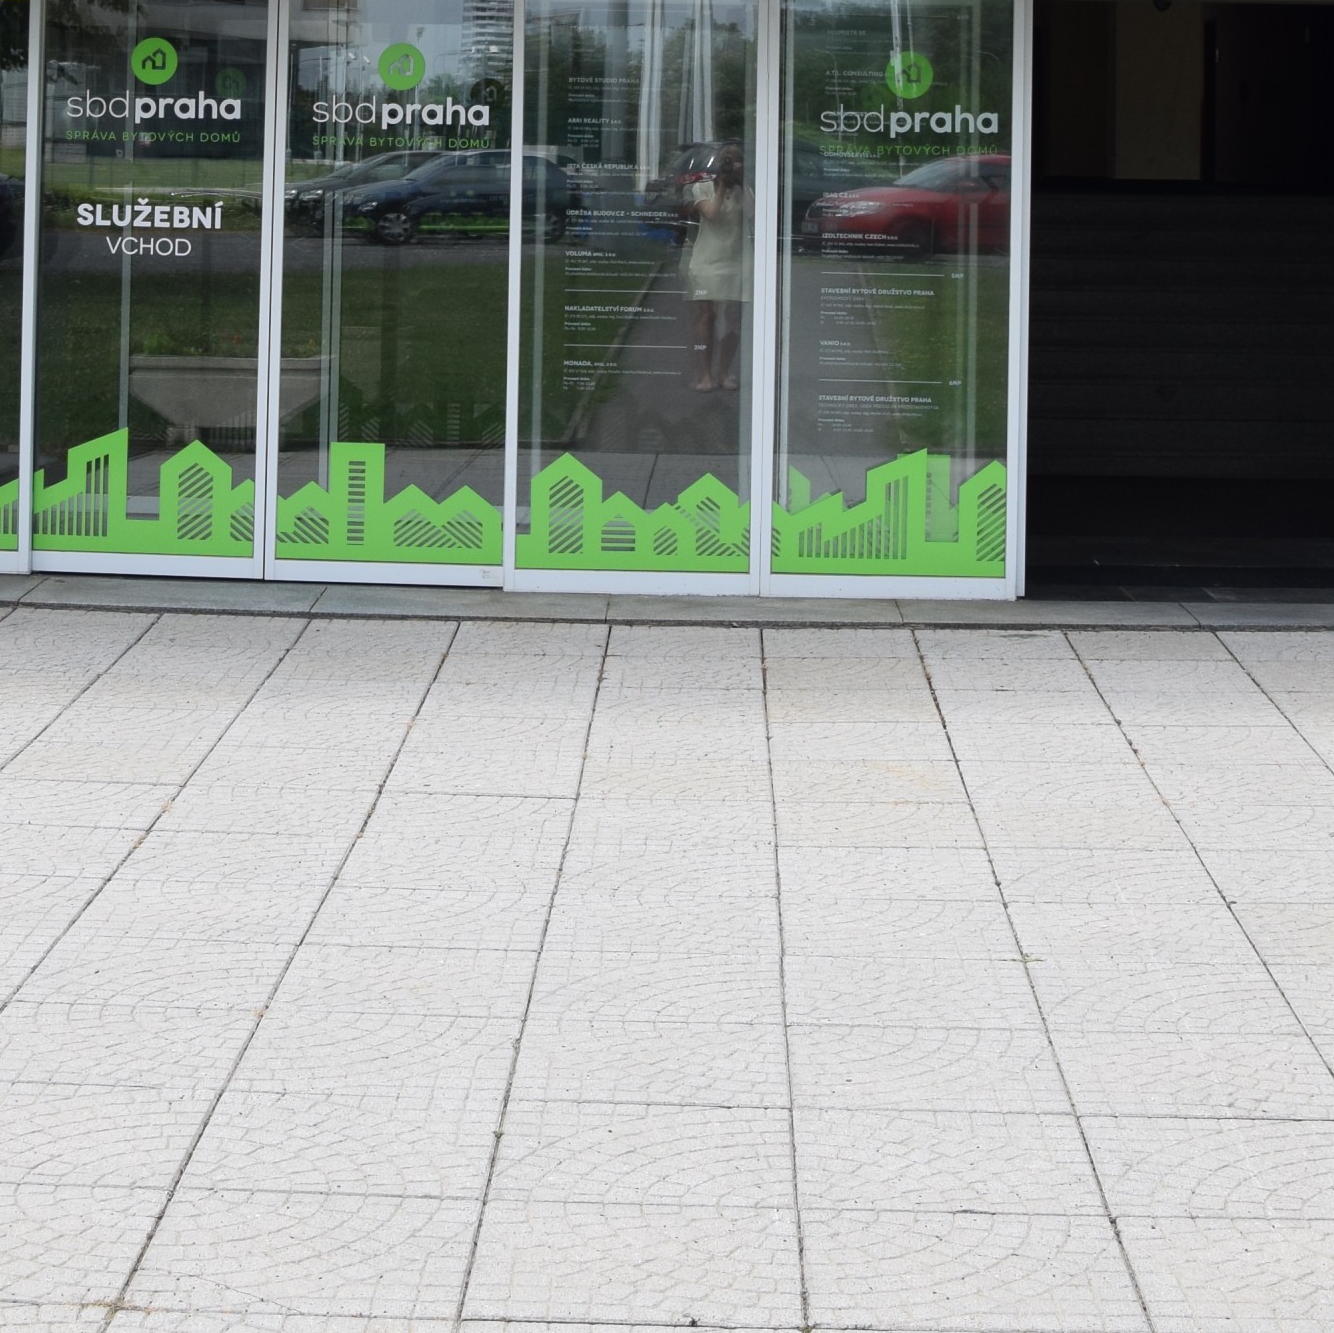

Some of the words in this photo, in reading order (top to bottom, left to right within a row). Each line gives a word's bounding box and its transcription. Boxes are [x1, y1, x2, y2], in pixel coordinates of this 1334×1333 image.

[67, 89, 241, 124] sbdpraha
[313, 95, 489, 129] sbdpraha
[820, 104, 998, 139] sbdpraha
[67, 130, 116, 140] SPRÁVA
[123, 131, 193, 142] BYTOVÝCH
[200, 131, 240, 142] DOMŮ
[313, 135, 363, 146] SPRÁVA
[370, 136, 441, 147] BYTOVÝCH
[449, 137, 489, 148] DOMŮ
[819, 145, 870, 156] SPRÁVA
[878, 145, 949, 155] BYTOVÝCH
[957, 144, 997, 155] DOMŮ
[77, 197, 223, 229] SLUŽEBNÍ
[106, 237, 191, 256] VCHOD
